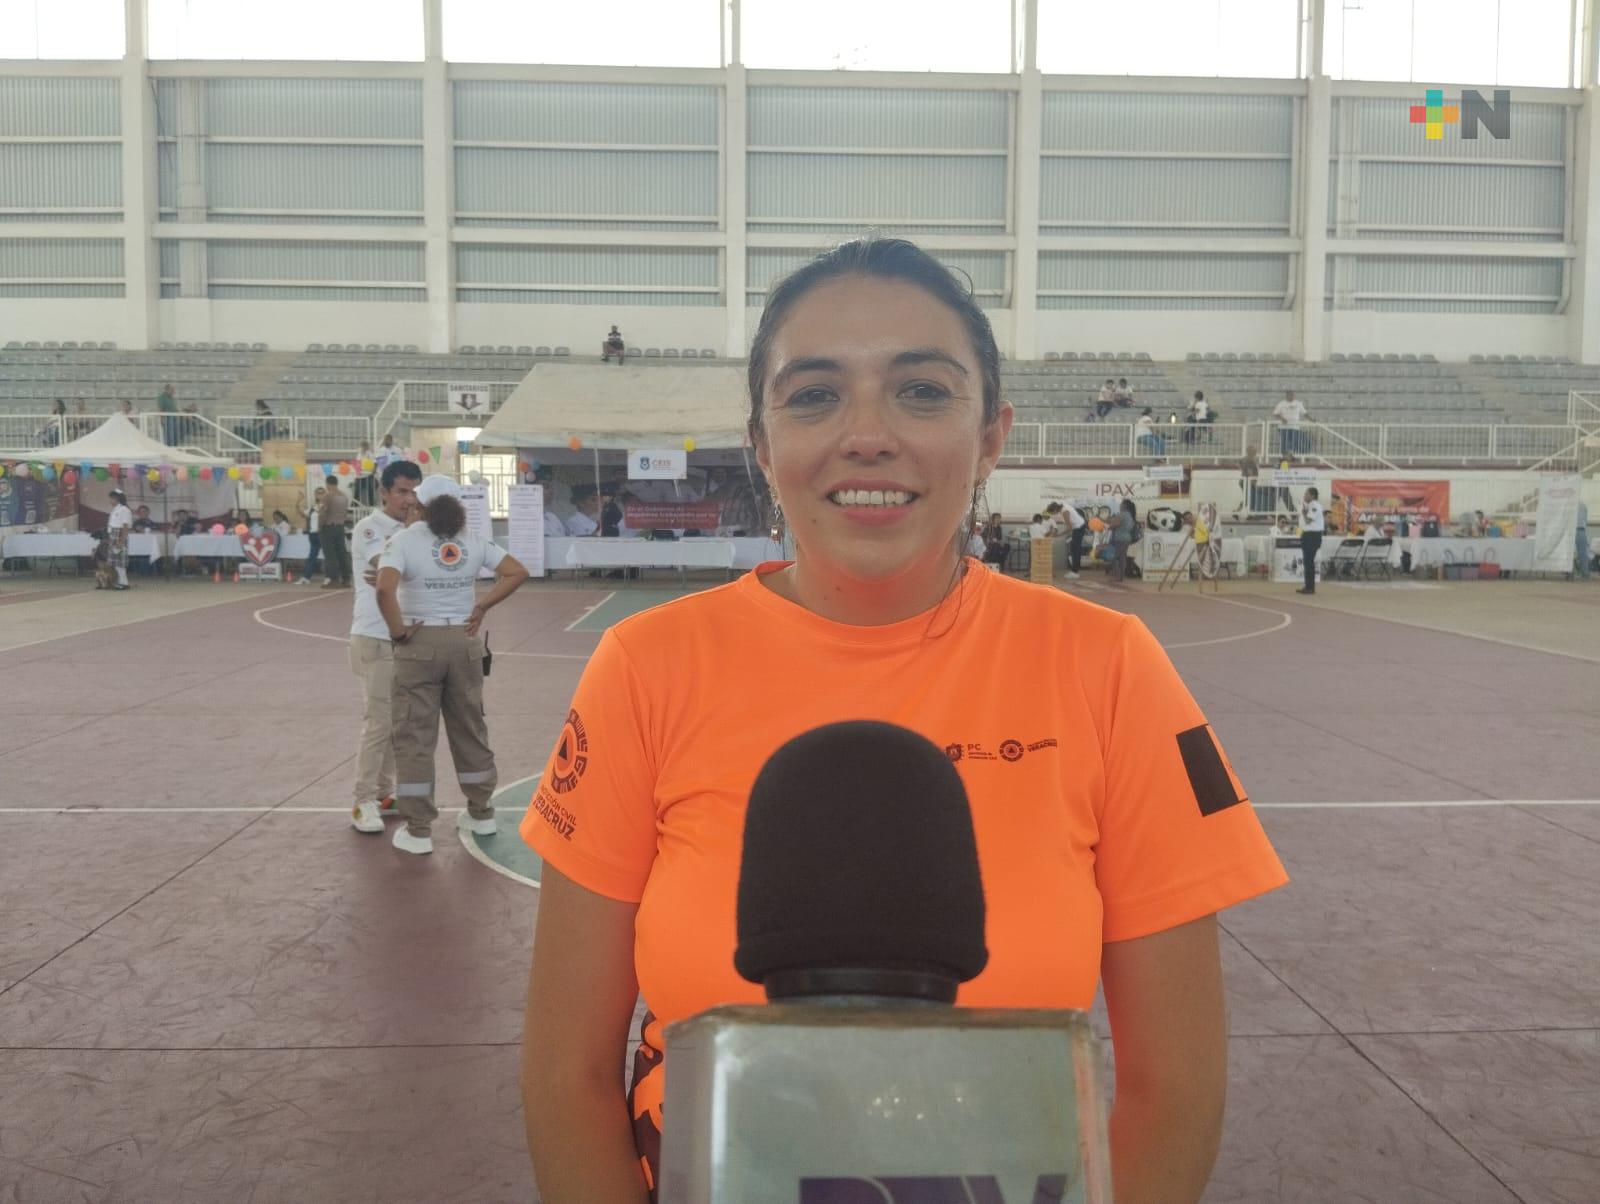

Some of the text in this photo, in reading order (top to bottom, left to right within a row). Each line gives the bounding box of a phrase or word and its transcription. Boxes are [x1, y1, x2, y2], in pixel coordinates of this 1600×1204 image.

[450, 384, 488, 392] SANITARIOS
[1095, 483, 1135, 497] IPAX
[967, 743, 982, 751] PC
